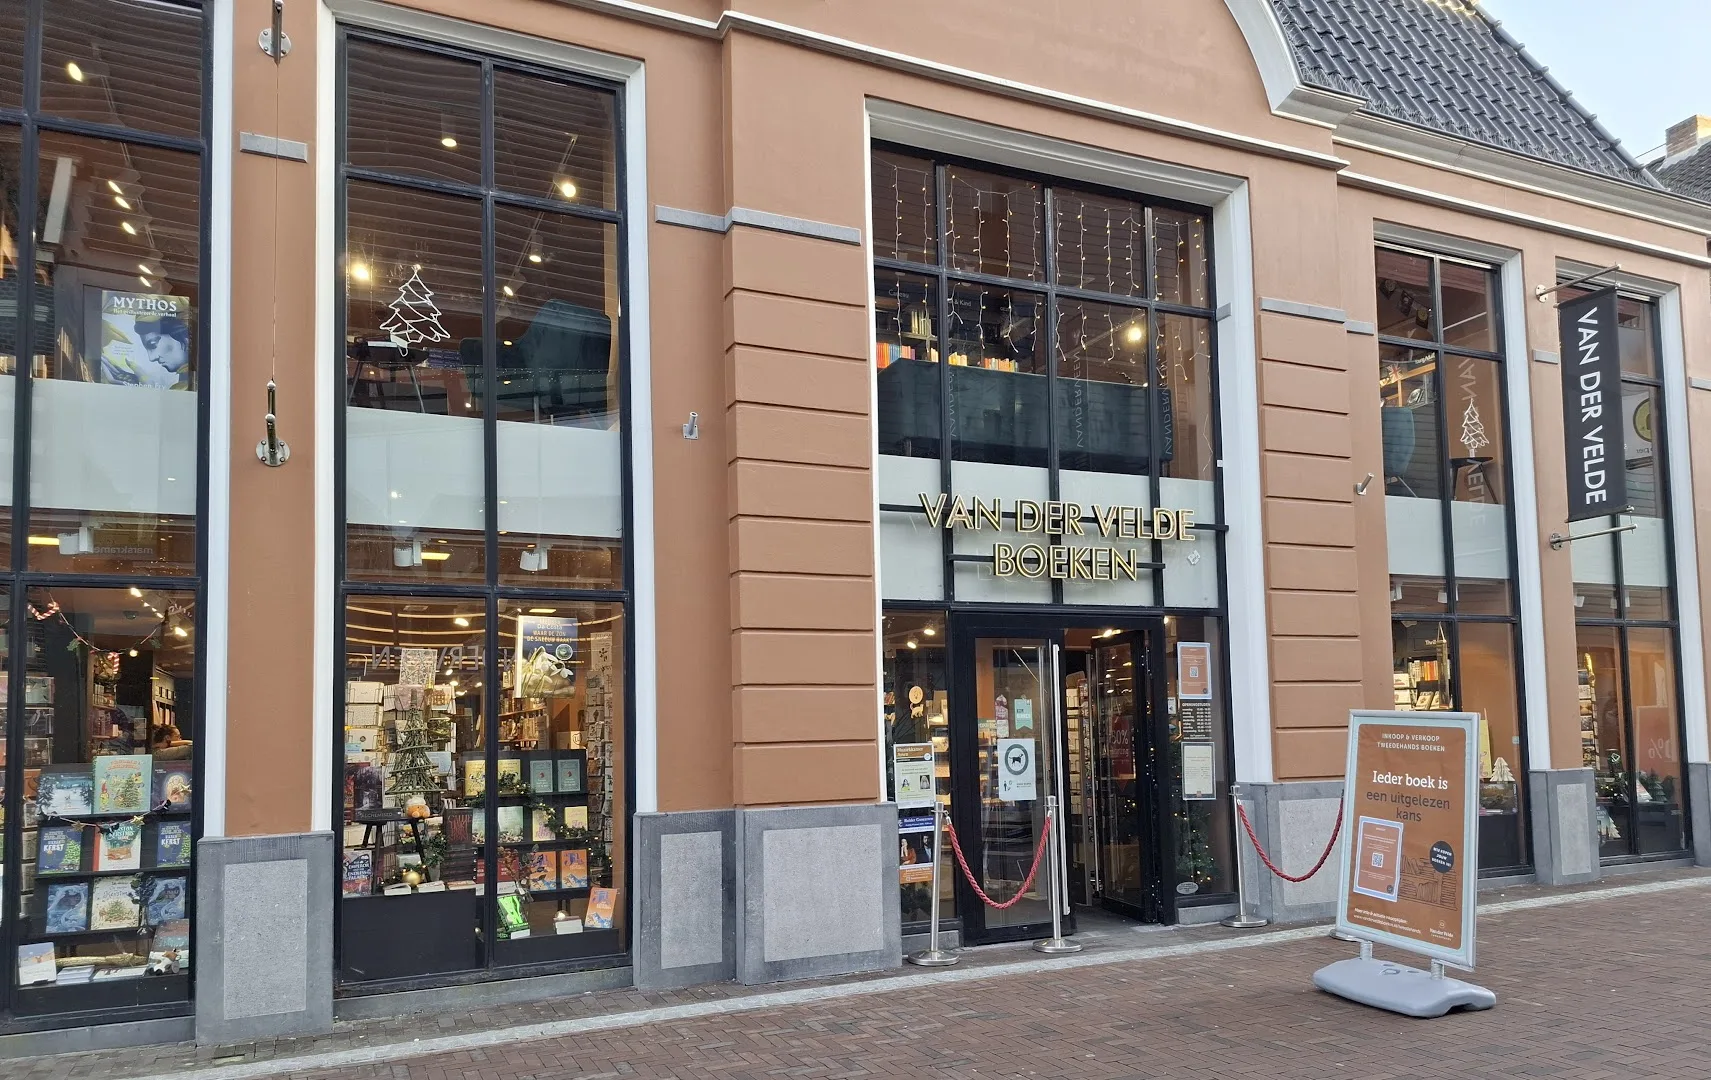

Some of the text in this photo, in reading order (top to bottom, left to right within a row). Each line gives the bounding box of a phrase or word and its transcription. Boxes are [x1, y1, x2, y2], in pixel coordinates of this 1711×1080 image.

[113, 296, 177, 312] MYTHOS
[1577, 306, 1607, 505] VAN DER VELDE
[918, 492, 1196, 541] VAN DER VELDE
[993, 543, 1138, 582] BOEKEN
[1377, 741, 1445, 752] TWEEDEHANDS BOEKEN
[1372, 770, 1448, 790] Ieder boek is
[1366, 791, 1450, 809] een uitgelezen
[1396, 807, 1422, 822] kans
[43, 843, 65, 852] KERST
[161, 838, 181, 846] KERST
